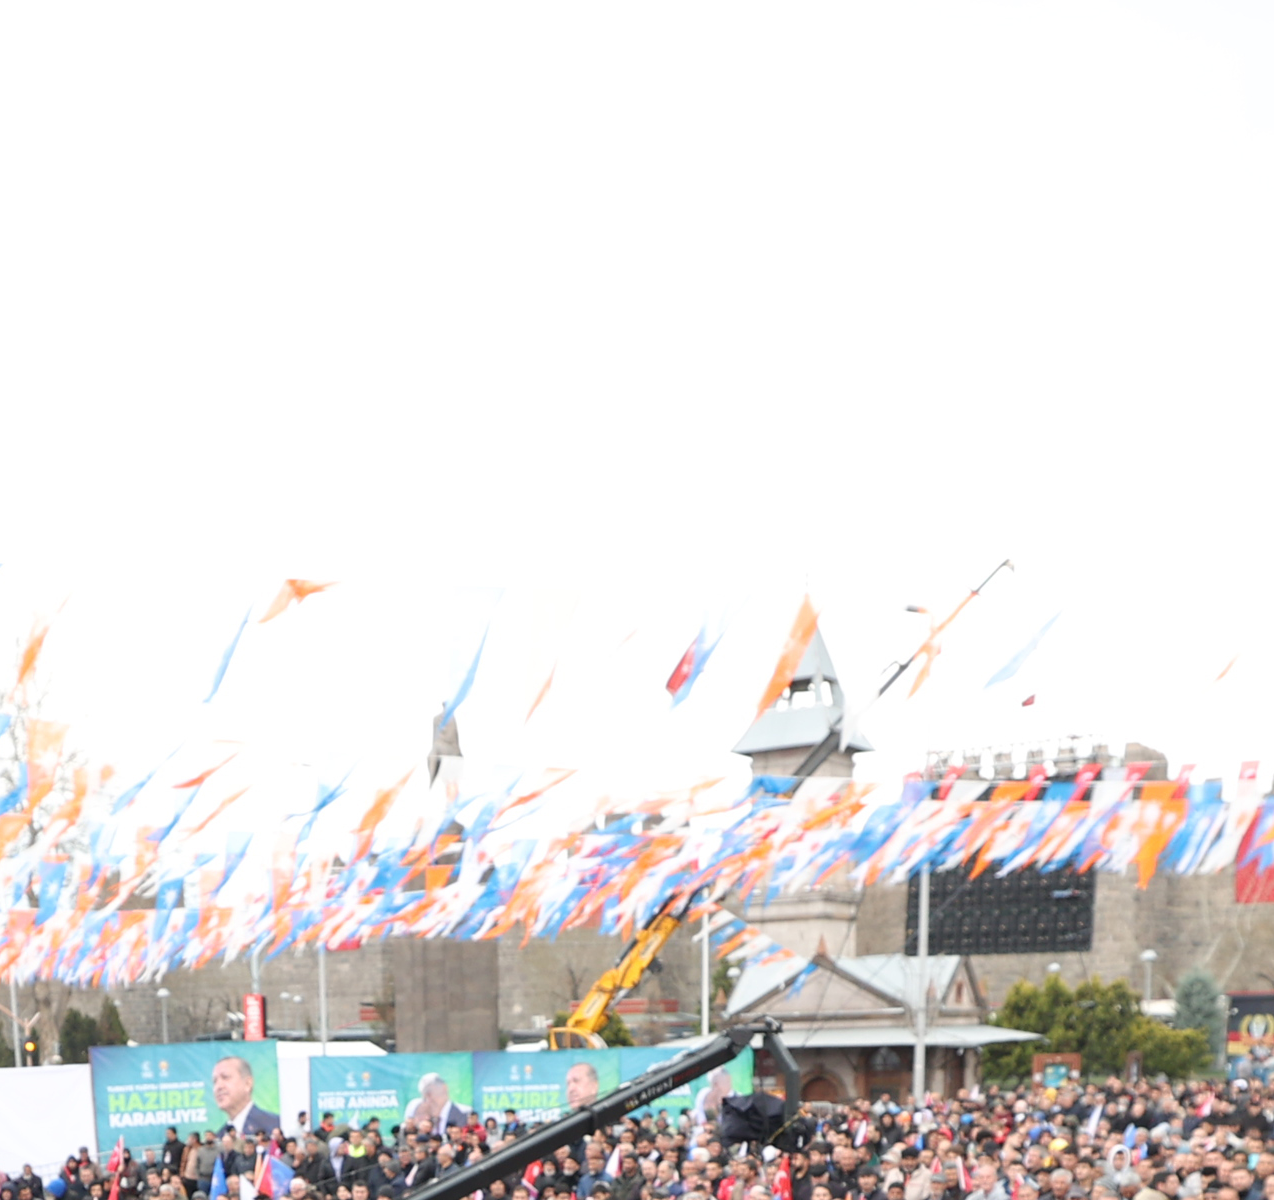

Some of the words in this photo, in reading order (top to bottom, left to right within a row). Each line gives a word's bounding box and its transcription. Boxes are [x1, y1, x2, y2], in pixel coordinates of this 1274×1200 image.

[108, 1089, 205, 1112] HAZIRIZ
[482, 1091, 560, 1110] HAZIRIZ
[109, 1107, 207, 1128] KARARLIYIZ
